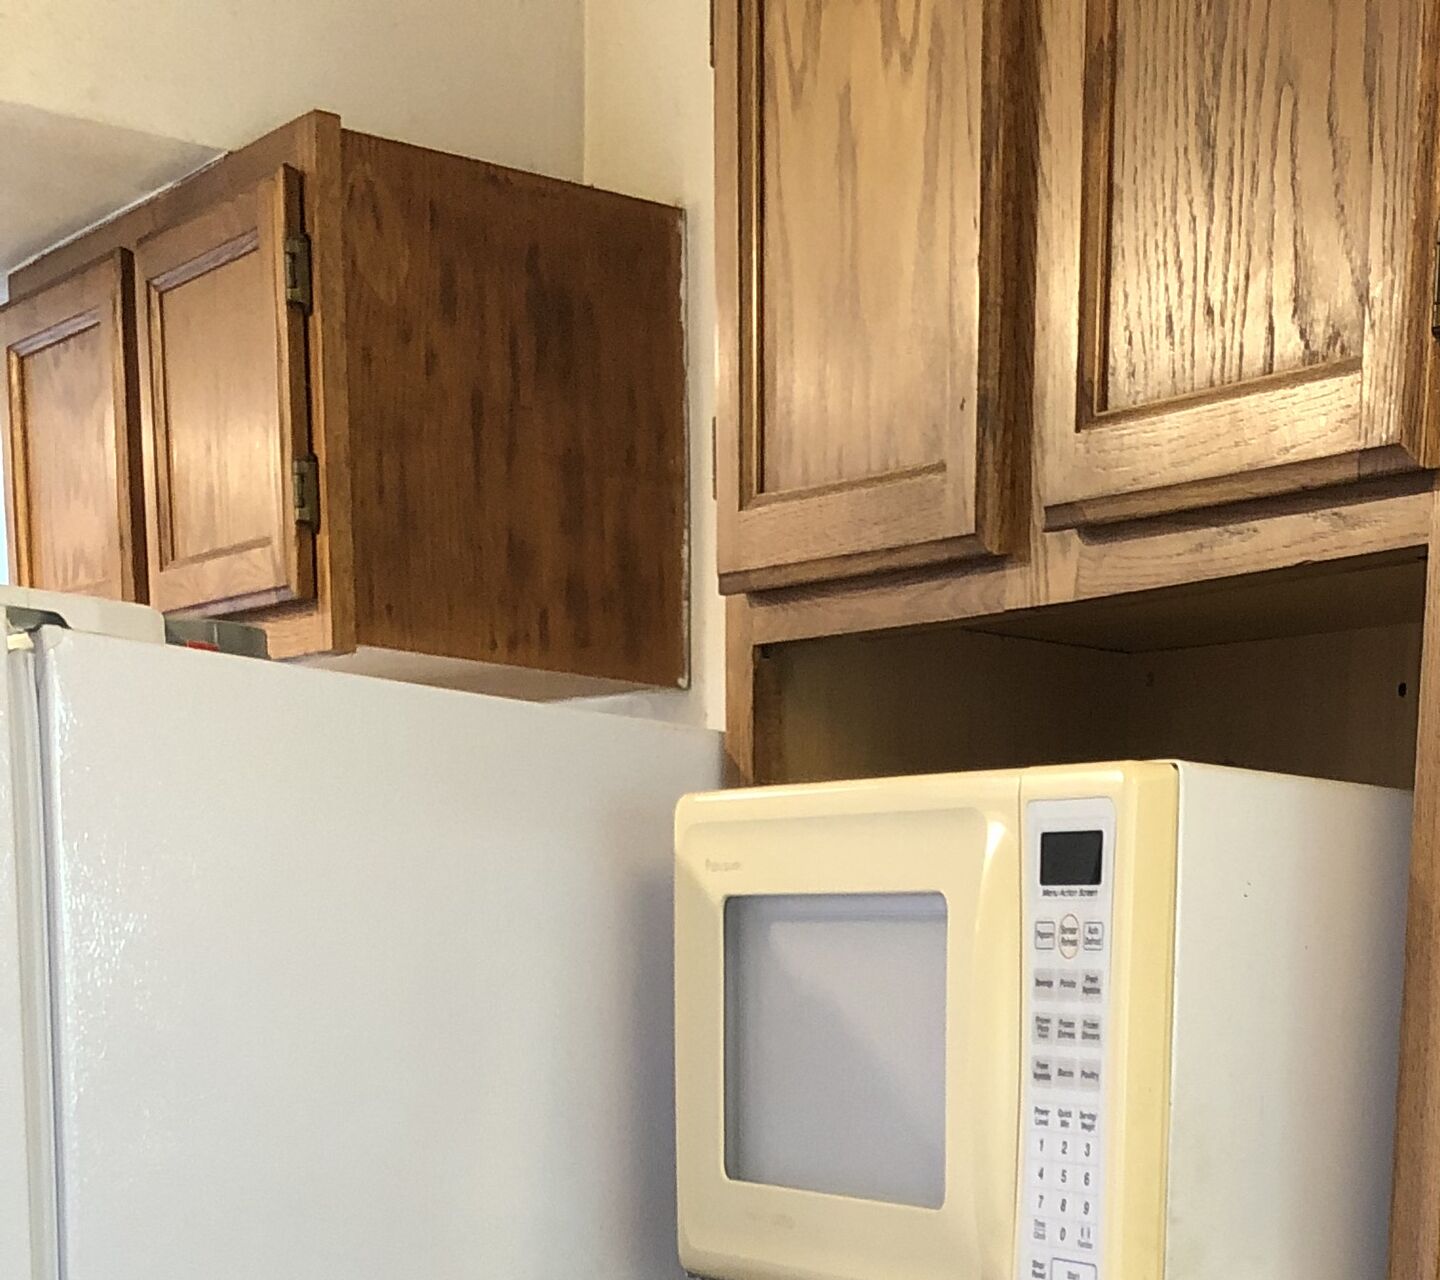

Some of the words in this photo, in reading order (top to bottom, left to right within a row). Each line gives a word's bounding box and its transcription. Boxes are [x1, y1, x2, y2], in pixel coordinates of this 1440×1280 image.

[1061, 1140, 1068, 1155] 2
[1084, 1142, 1091, 1157] 3
[1038, 1167, 1044, 1180] 4
[1060, 1169, 1068, 1183] 5
[1084, 1171, 1090, 1186] 6
[1038, 1194, 1044, 1209] 7
[1060, 1198, 1067, 1213] 8
[1083, 1200, 1090, 1215] 9
[1060, 1226, 1067, 1241] 0
